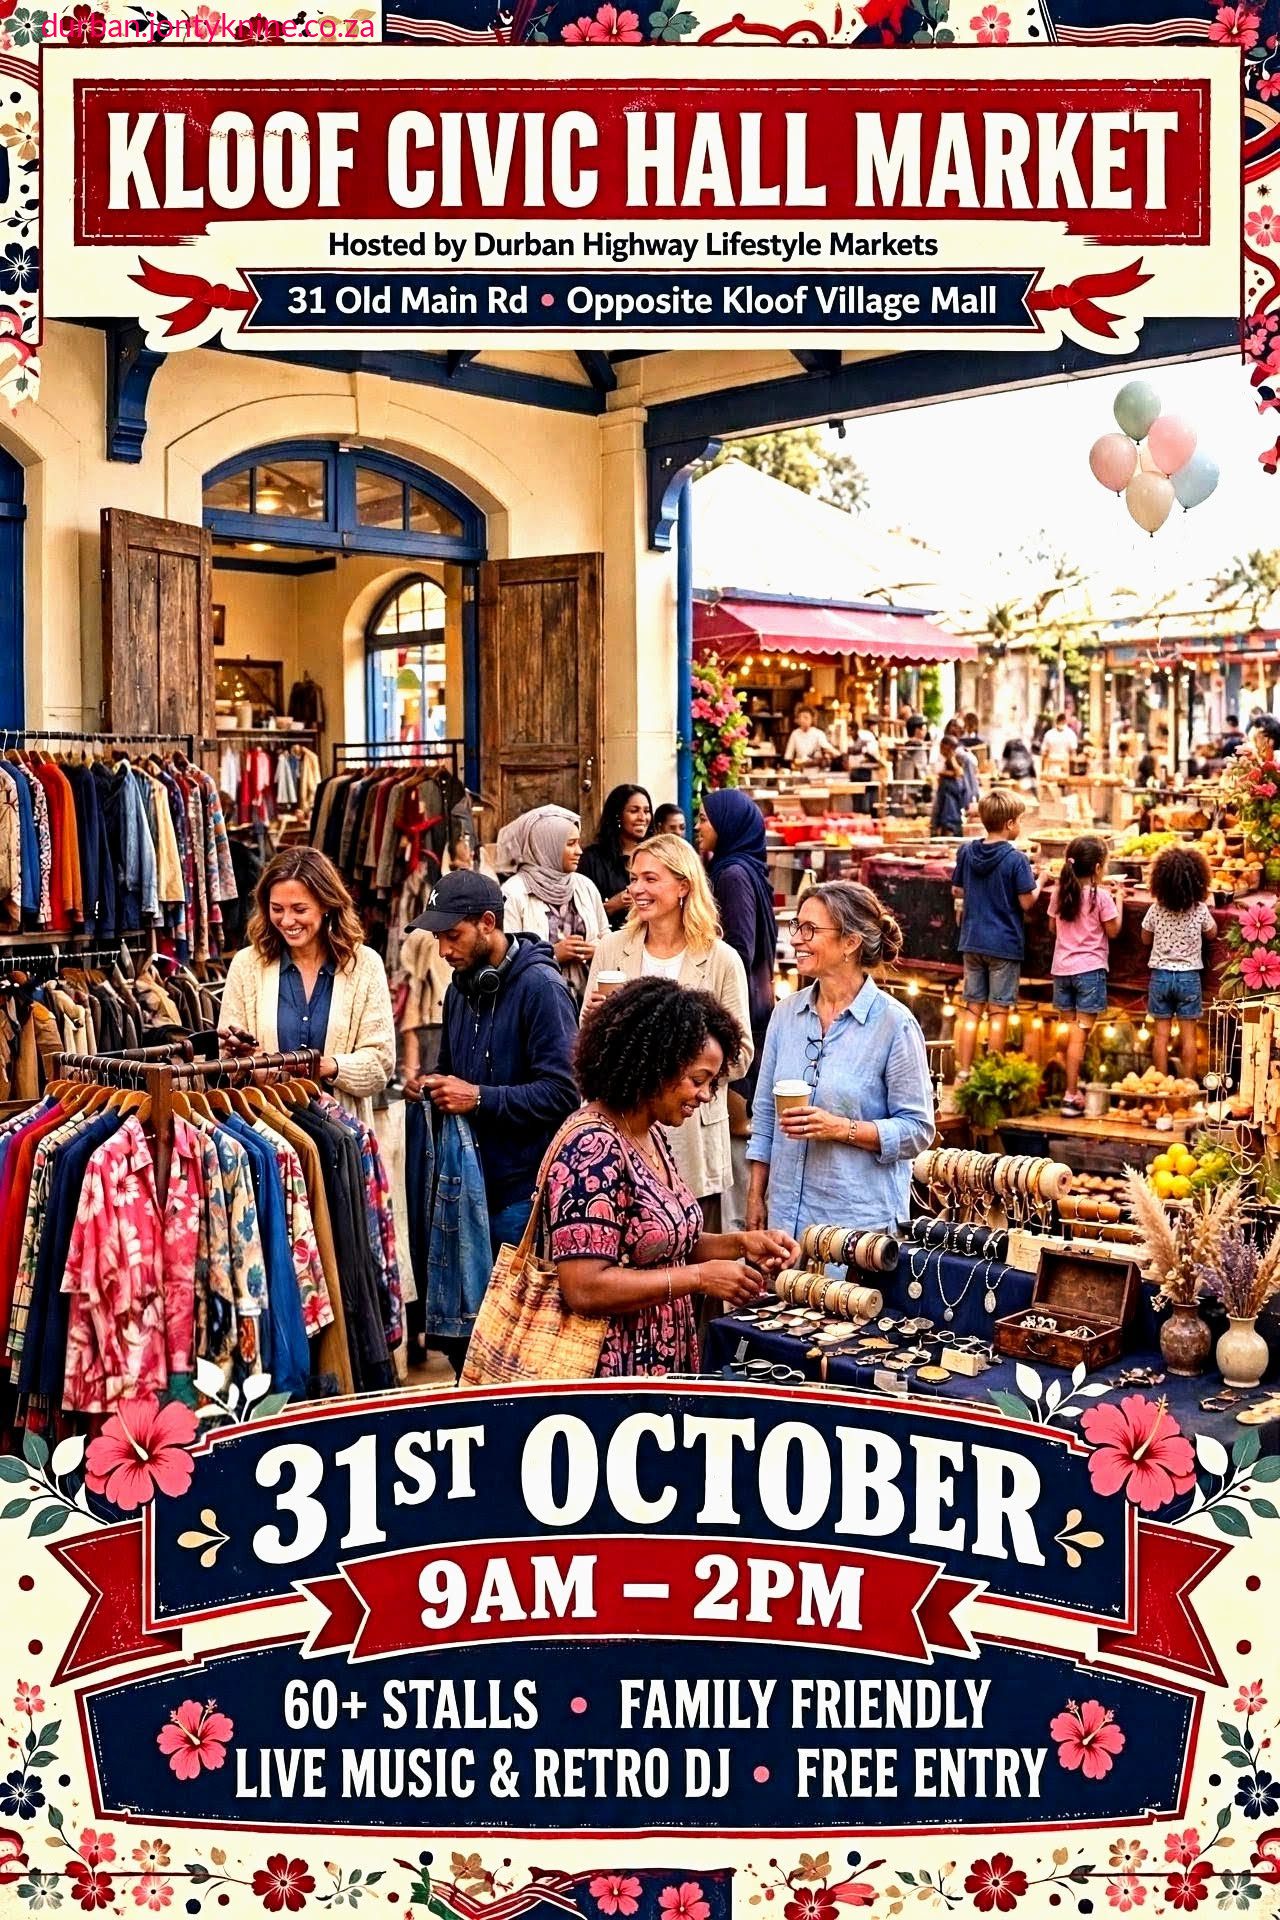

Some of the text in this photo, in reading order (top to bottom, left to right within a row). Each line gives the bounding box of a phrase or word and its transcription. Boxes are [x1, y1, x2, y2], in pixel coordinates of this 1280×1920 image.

[107, 108, 1179, 210] KLOOF CIVIC HALL MARKET
[329, 230, 939, 263] Hosted by Durban Highway Lifestyle Markets
[287, 285, 996, 321] 31 Old Main Rd Opposite Kloof Village Mall
[520, 1412, 1046, 1567] OCTOBER
[418, 1554, 598, 1630] 9AM
[692, 1553, 865, 1632] 2PM
[284, 1678, 992, 1730] 60+ STALLS FAMILY FRIENDLY
[235, 1747, 1048, 1798] LIVE MUSIC & RETRO DJ FREE ENTRY
